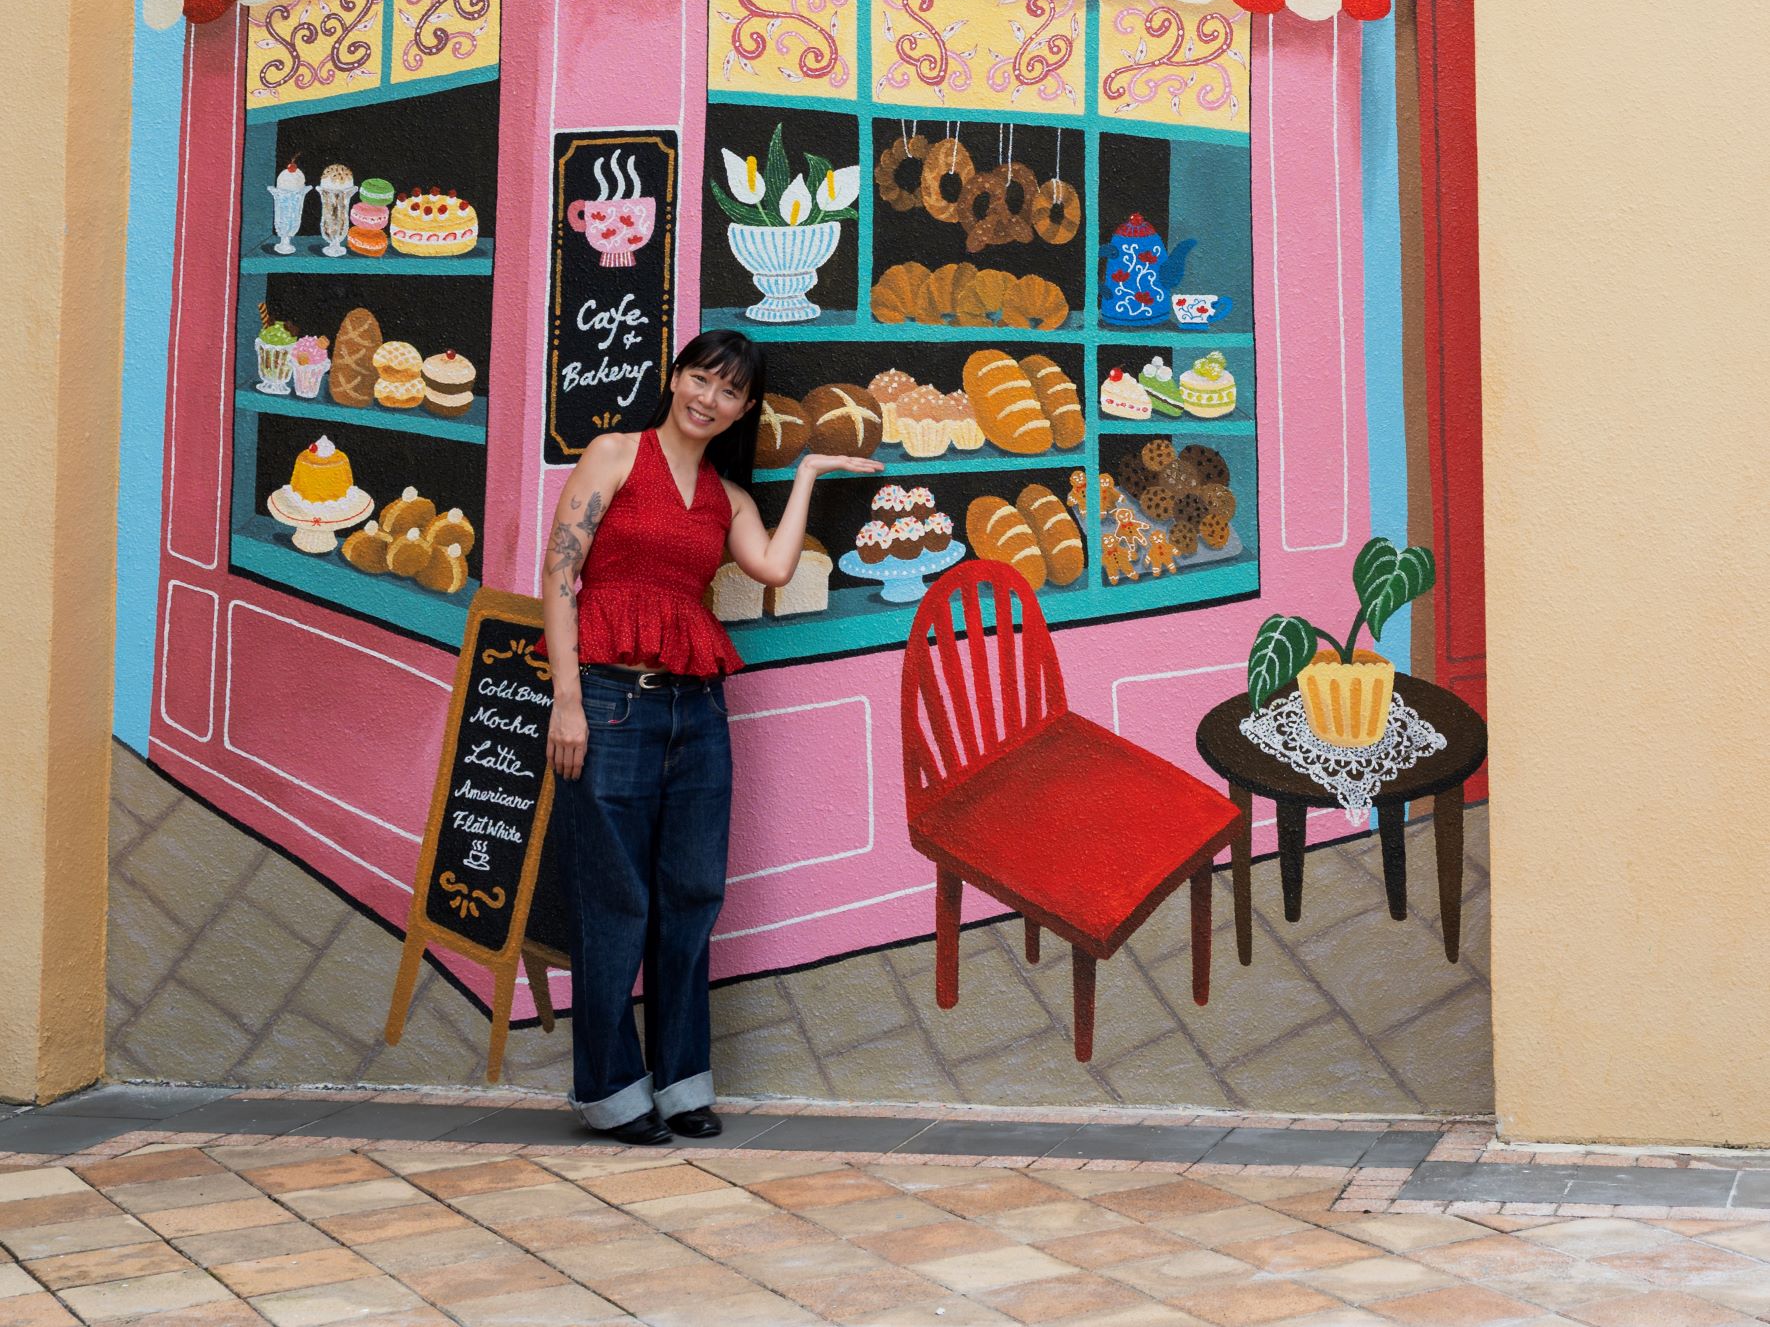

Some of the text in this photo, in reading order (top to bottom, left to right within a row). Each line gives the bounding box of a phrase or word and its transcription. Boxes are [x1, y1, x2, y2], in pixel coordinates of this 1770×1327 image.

[576, 293, 649, 350] Cafe
[562, 356, 653, 407] Bakery
[478, 677, 518, 700] Cold
[469, 706, 539, 738] Mocha
[464, 740, 534, 778] Latte
[454, 779, 535, 810] Americano
[452, 811, 522, 843] Flat White
